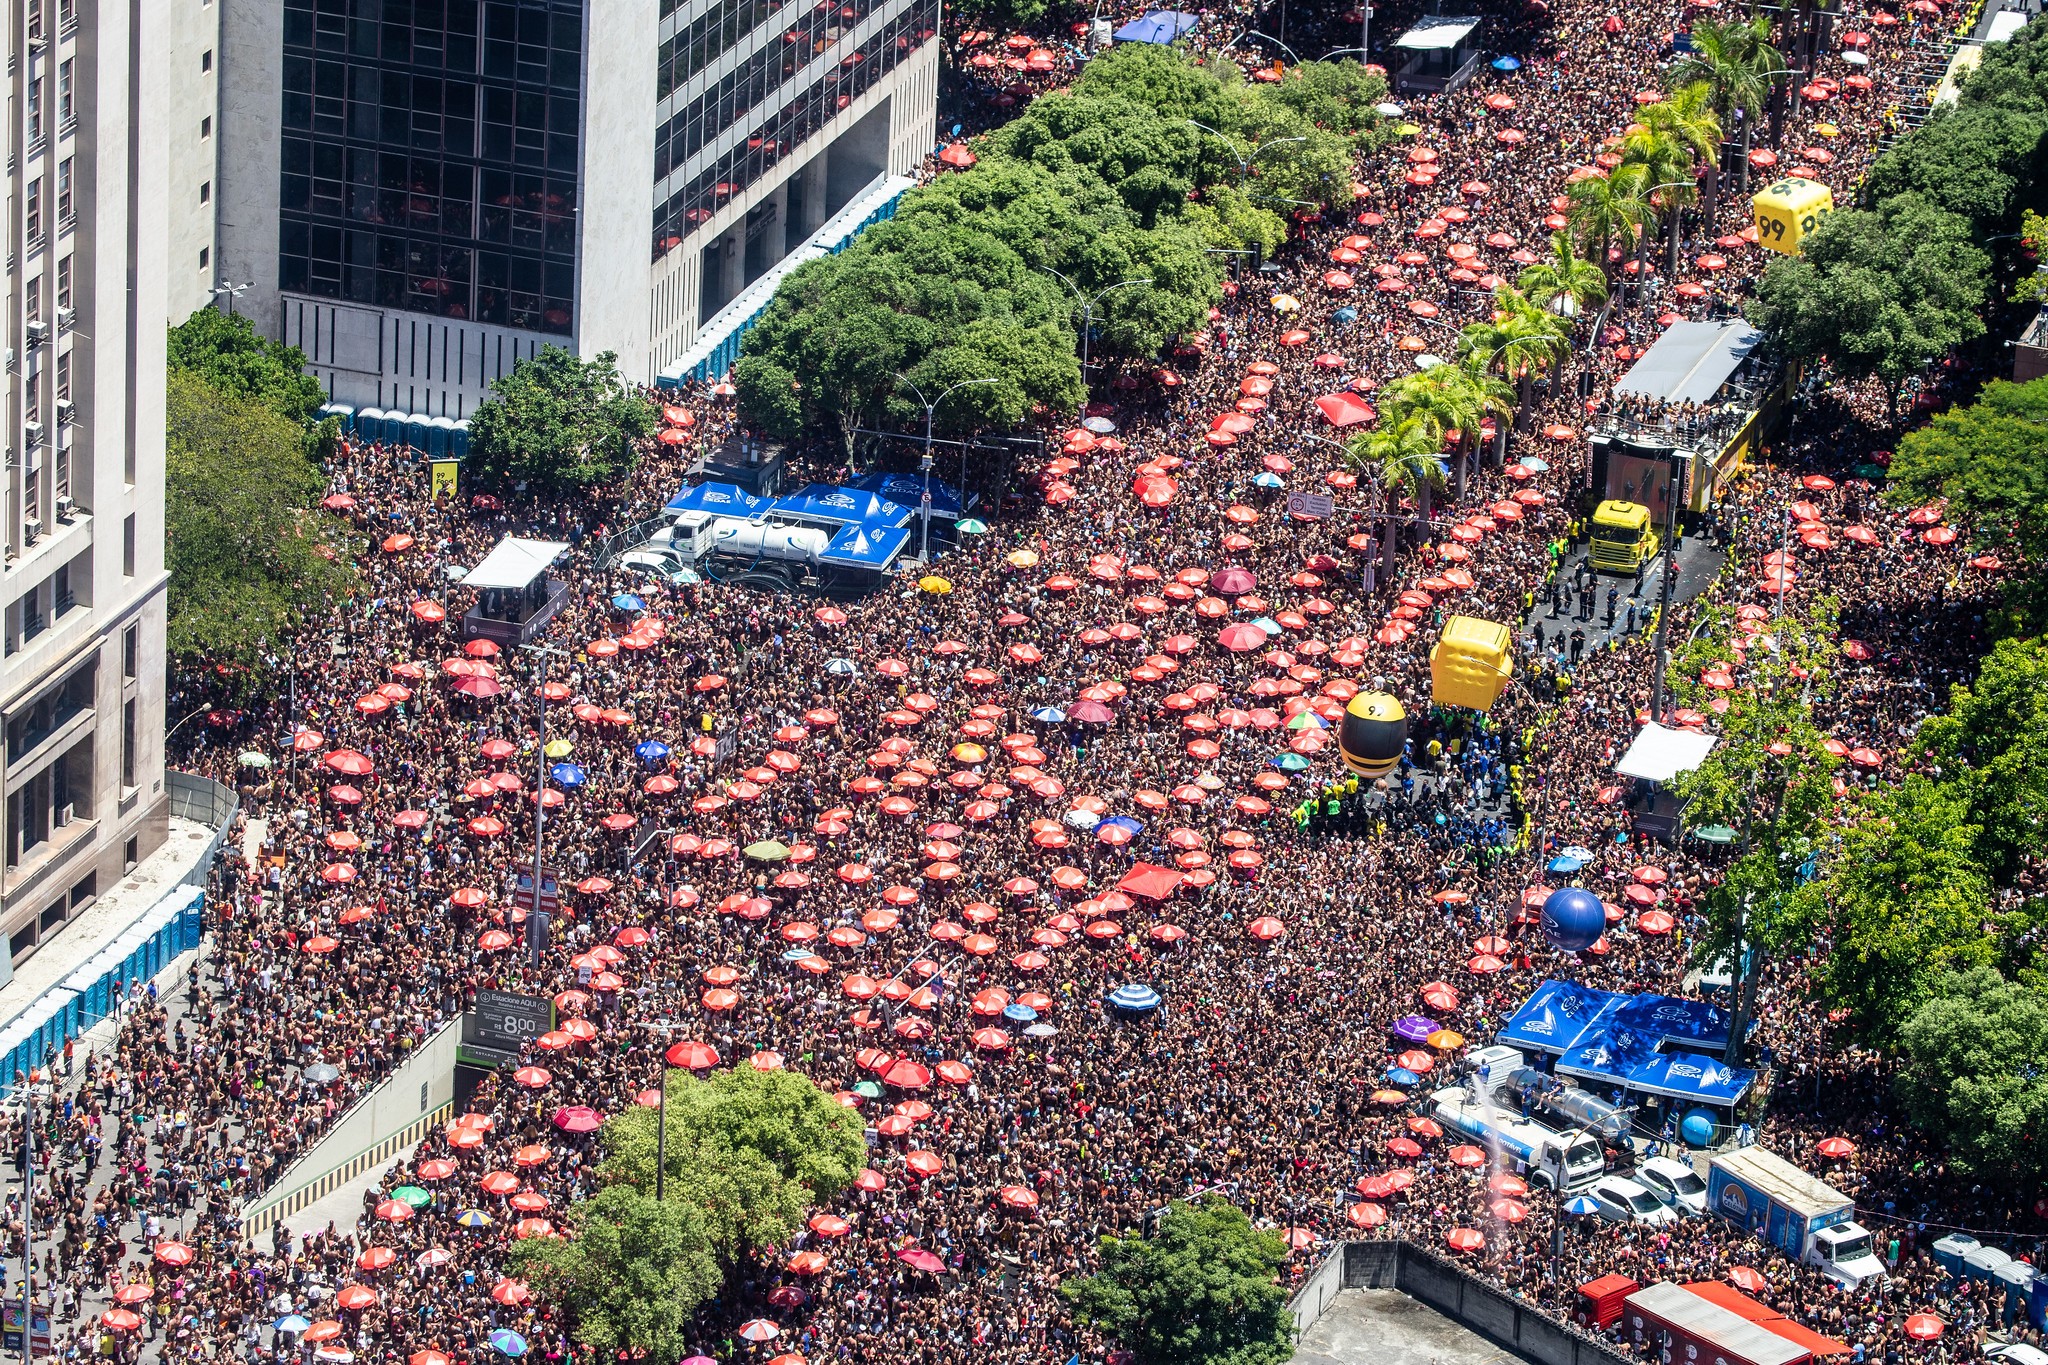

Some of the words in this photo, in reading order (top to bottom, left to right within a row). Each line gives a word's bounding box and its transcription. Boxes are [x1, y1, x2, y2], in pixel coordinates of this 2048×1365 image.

[1759, 215, 1786, 242] 99
[884, 487, 921, 496] CEDAE
[702, 496, 731, 504] CEDAE
[819, 500, 856, 510] CEDAE
[491, 994, 520, 1005] Estacione
[520, 999, 536, 1007] AQUI
[1566, 999, 1585, 1018] CEDAE
[1651, 1013, 1692, 1025] CEDAE
[504, 1016, 535, 1034] 8,00
[1521, 1026, 1553, 1037] CEDAE
[1575, 1069, 1608, 1079] AGUADEIROS
[1670, 1069, 1703, 1079] CEDAE
[1498, 1138, 1522, 1154] POTÁVEL
